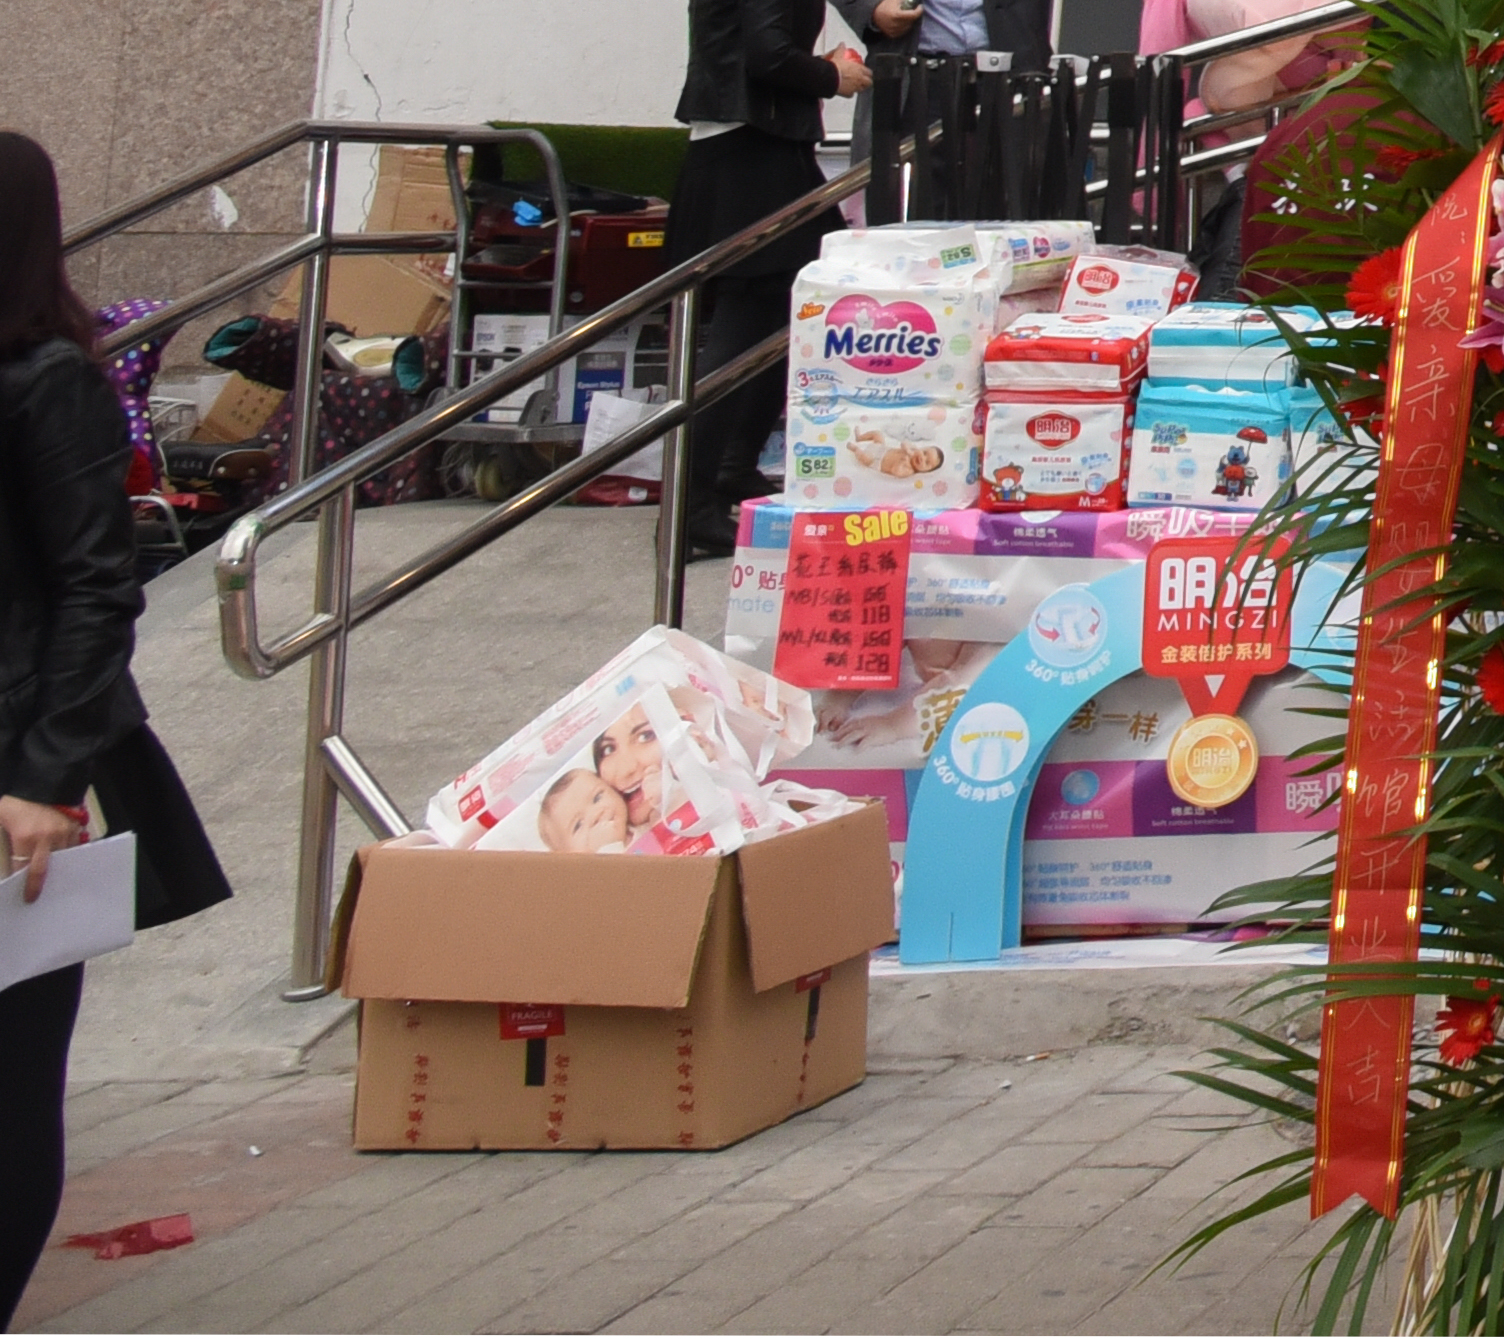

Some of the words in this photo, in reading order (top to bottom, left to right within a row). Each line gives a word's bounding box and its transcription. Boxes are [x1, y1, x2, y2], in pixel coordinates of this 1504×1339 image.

[823, 326, 942, 360] Merries
[844, 510, 908, 546] Sale
[1158, 556, 1278, 612] 明治
[1158, 611, 1278, 632] MINGZI
[1161, 642, 1272, 664] 金装倍护系列
[511, 1009, 554, 1022] FRAGILE
